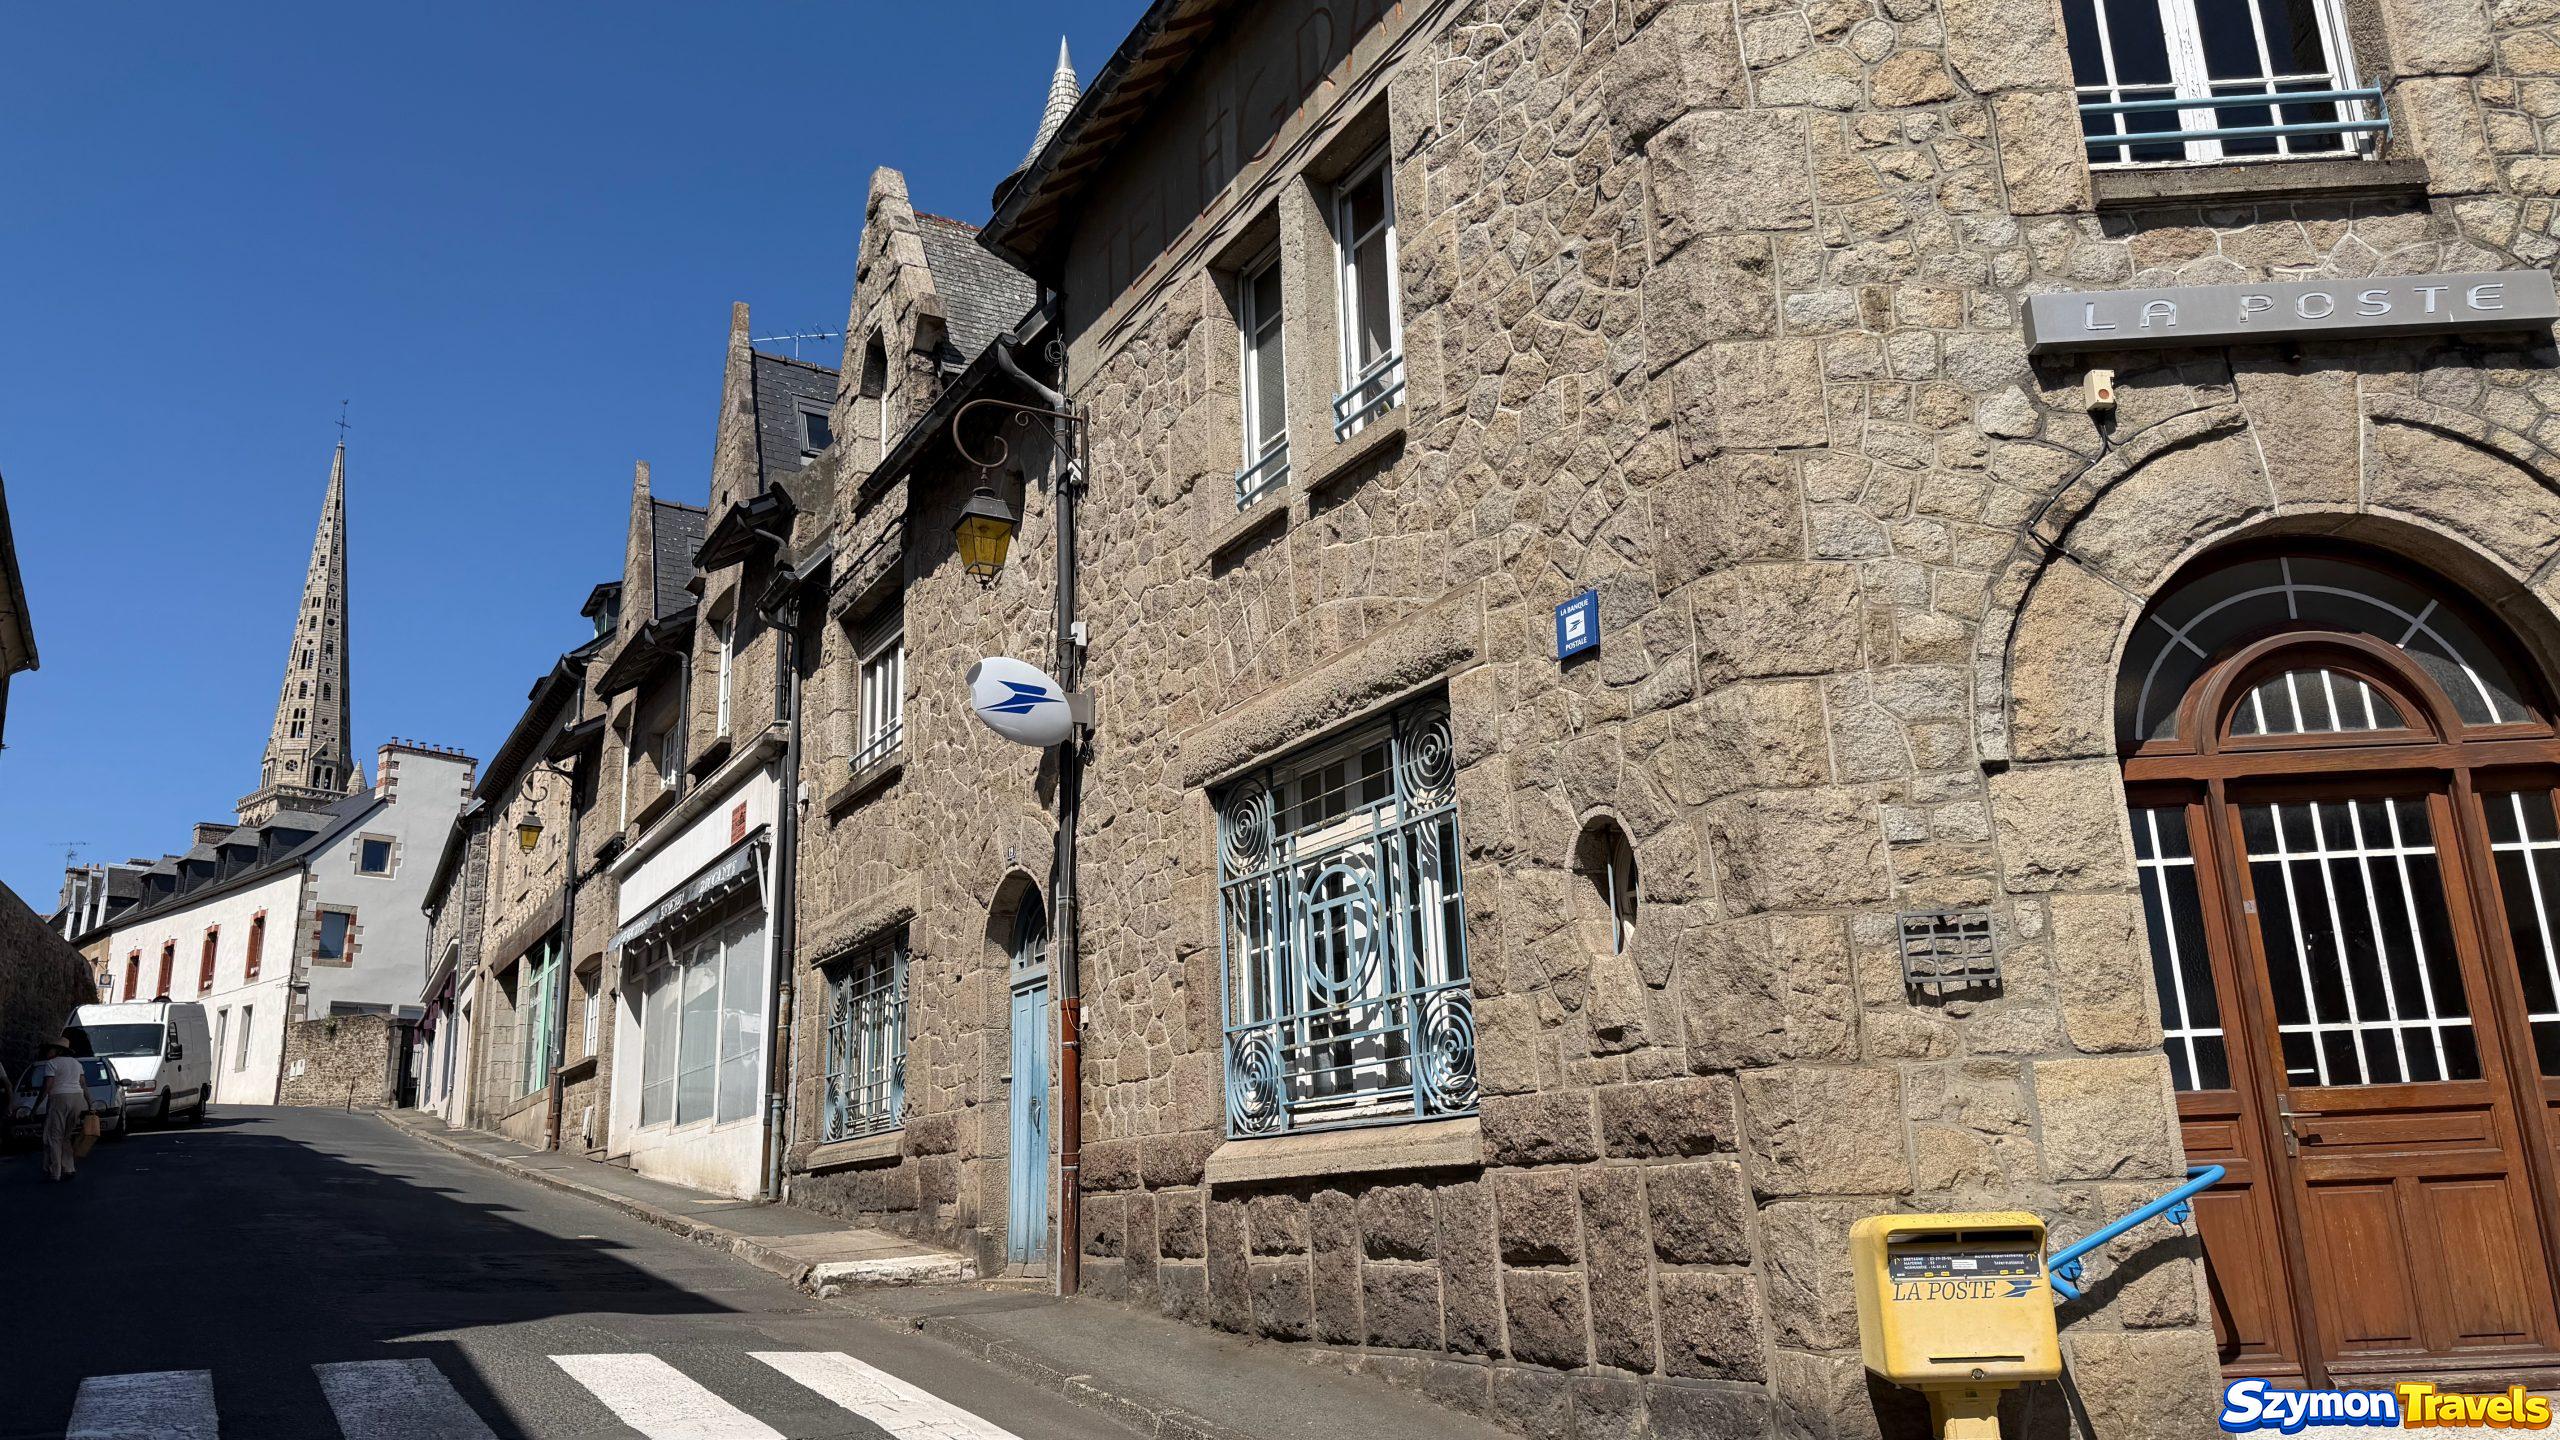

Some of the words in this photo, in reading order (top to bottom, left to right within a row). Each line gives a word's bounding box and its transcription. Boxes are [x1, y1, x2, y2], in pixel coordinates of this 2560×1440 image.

[2084, 299, 2177, 330] LA
[2239, 283, 2504, 323] POSTE
[1567, 598, 1589, 614] BANQUE
[1565, 636, 1588, 651] POSTALE
[1892, 1282, 1922, 1301] LA
[1926, 1280, 1996, 1301] POSTE
